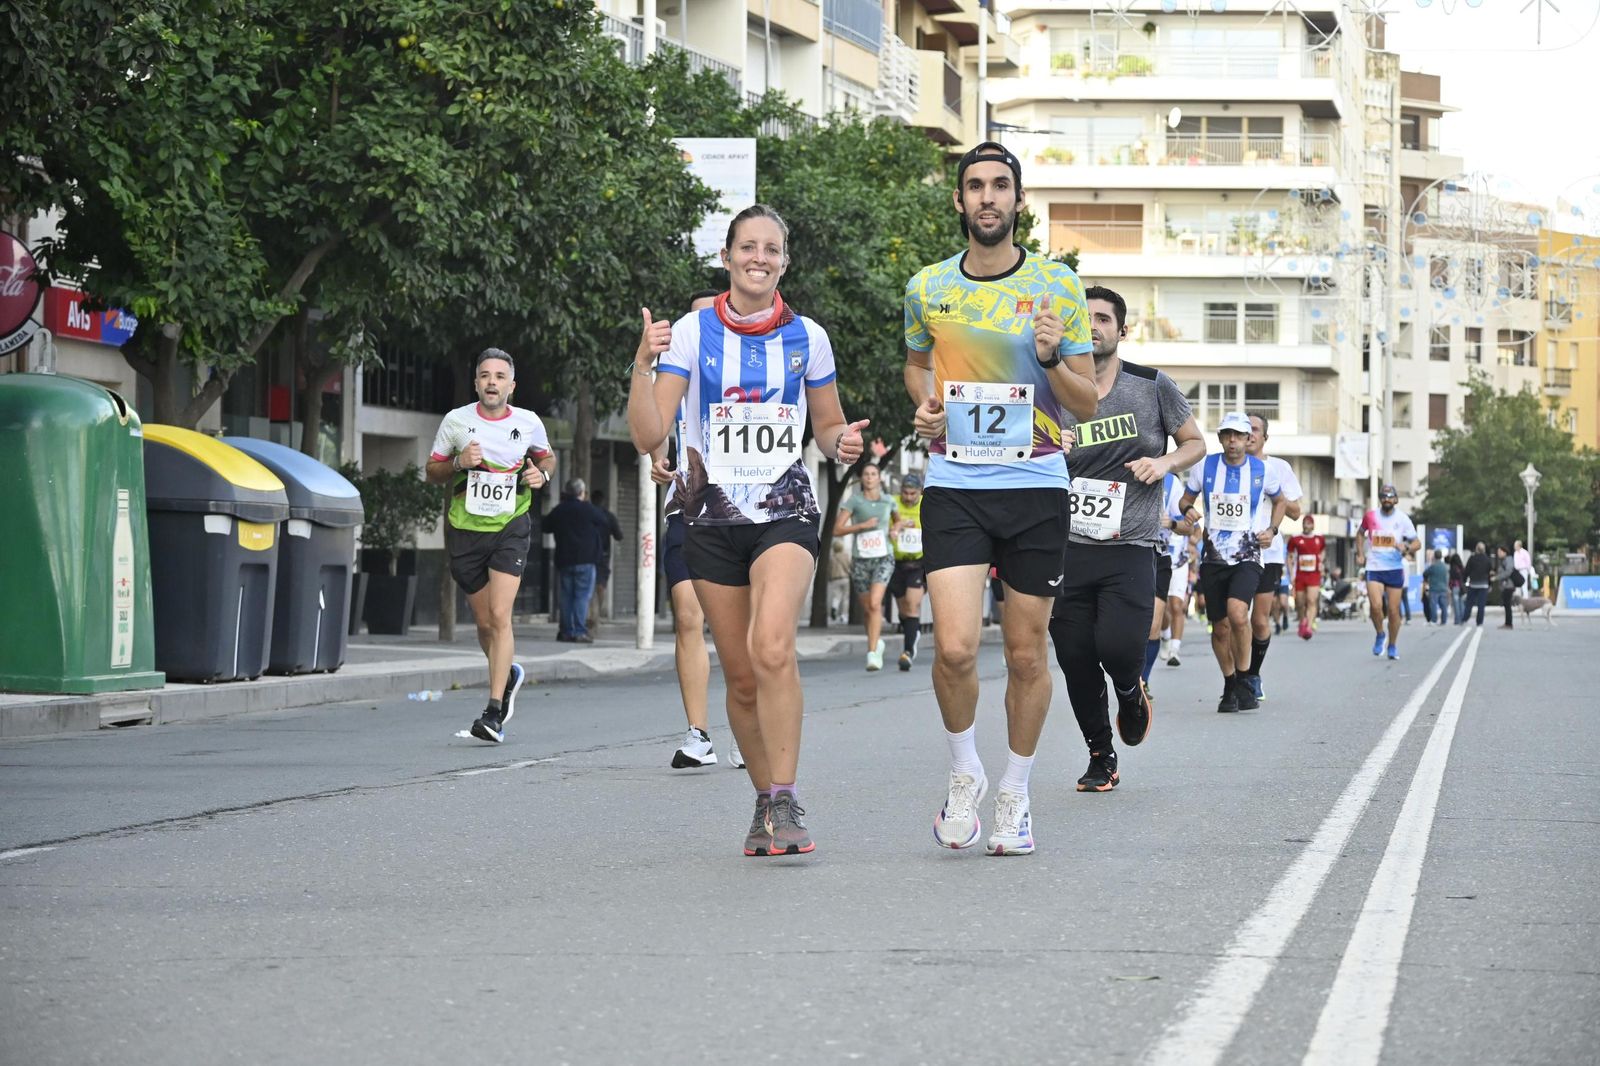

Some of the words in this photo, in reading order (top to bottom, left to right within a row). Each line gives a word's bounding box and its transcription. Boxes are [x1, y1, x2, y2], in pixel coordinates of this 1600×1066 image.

[967, 404, 1006, 434] 12
[1076, 426, 1084, 445] I
[1090, 415, 1137, 442] RUN
[717, 425, 797, 453] 1104
[470, 482, 514, 501] 1067
[1068, 494, 1112, 518] 852
[1216, 503, 1243, 516] 589
[862, 537, 881, 548] 900
